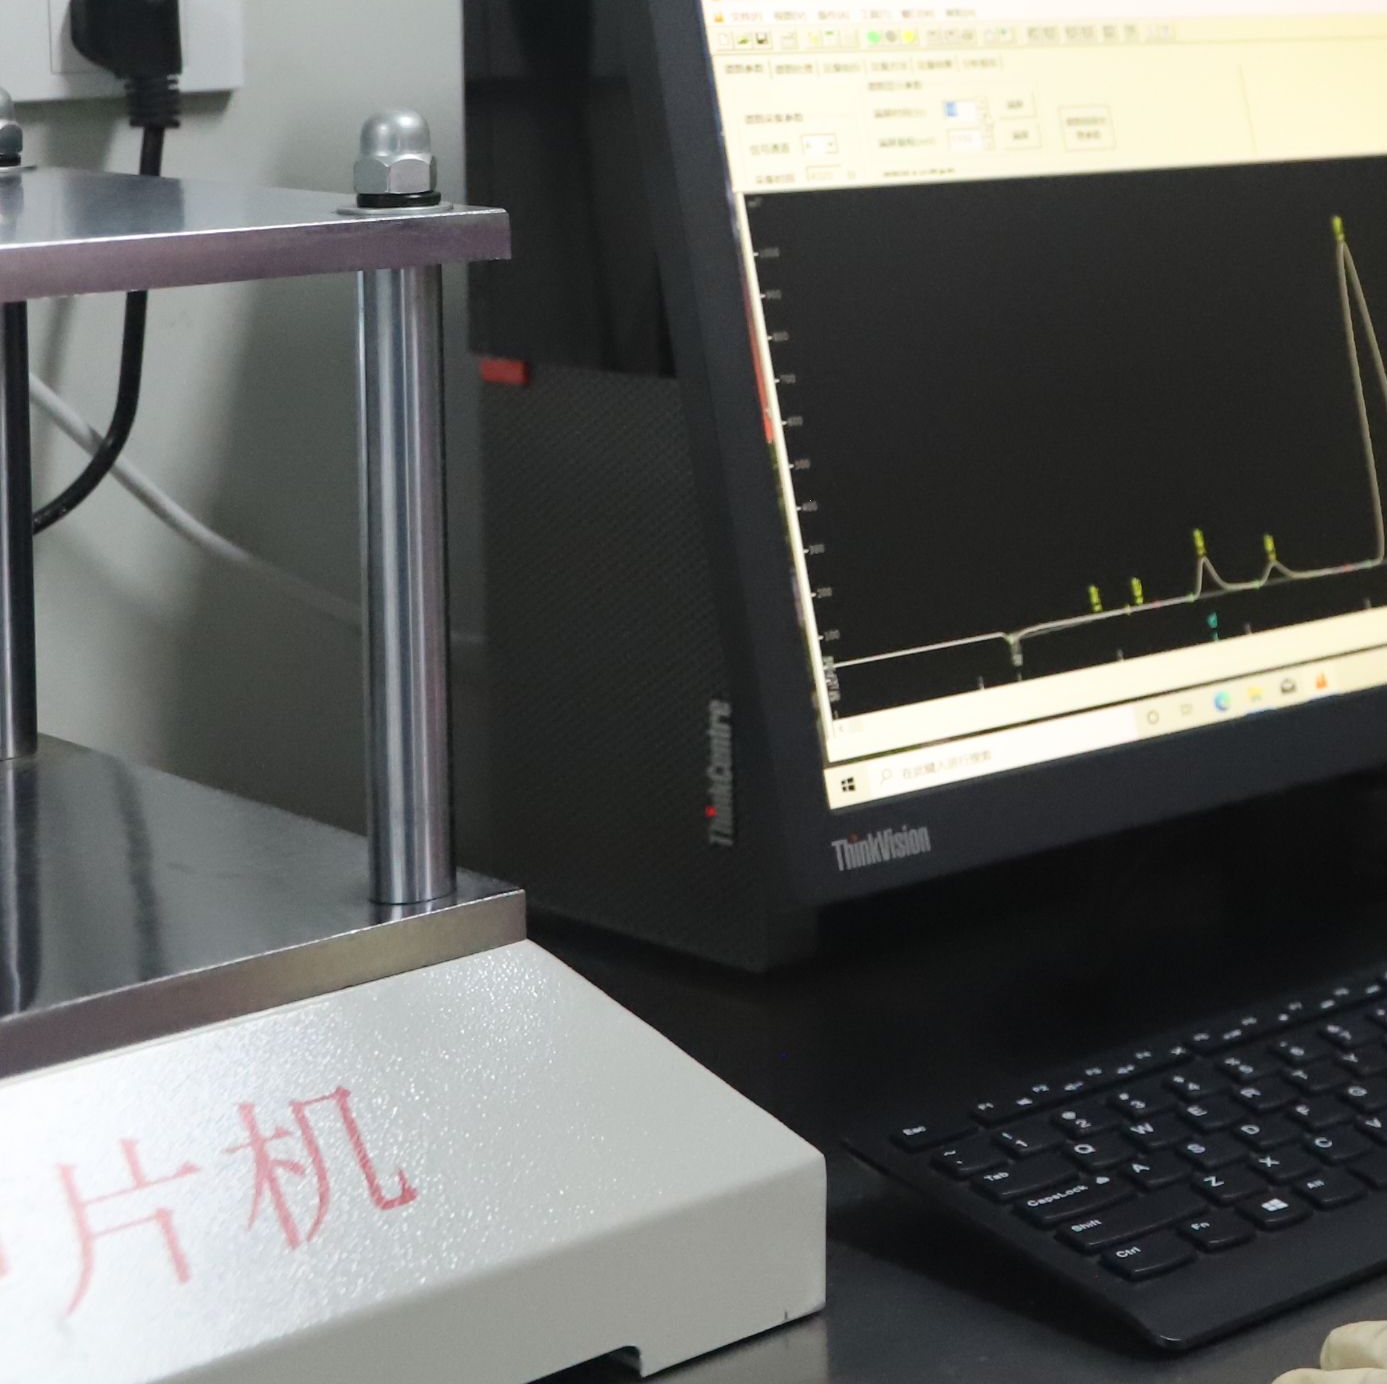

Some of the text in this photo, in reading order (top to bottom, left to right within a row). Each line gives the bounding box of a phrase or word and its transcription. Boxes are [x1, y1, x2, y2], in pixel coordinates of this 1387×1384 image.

[831, 824, 932, 872] ThinkVision
[1187, 1105, 1208, 1117] E
[1075, 1118, 1092, 1128] 2
[1130, 1122, 1154, 1135] W
[1240, 1124, 1261, 1135] D
[1074, 1143, 1096, 1154] Q
[1314, 1137, 1333, 1148] C
[1259, 1156, 1280, 1168] X
[1131, 1163, 1151, 1174] A
[983, 1172, 1010, 1182] Tab
[1203, 1176, 1225, 1188] Z
[1307, 1179, 1326, 1190] Alt
[0, 1084, 419, 1318] 片机
[1027, 1185, 1089, 1207] CapsLock
[1071, 1219, 1102, 1233] Shift
[1190, 1221, 1211, 1231] Fn
[1116, 1246, 1141, 1258] Ctrl
